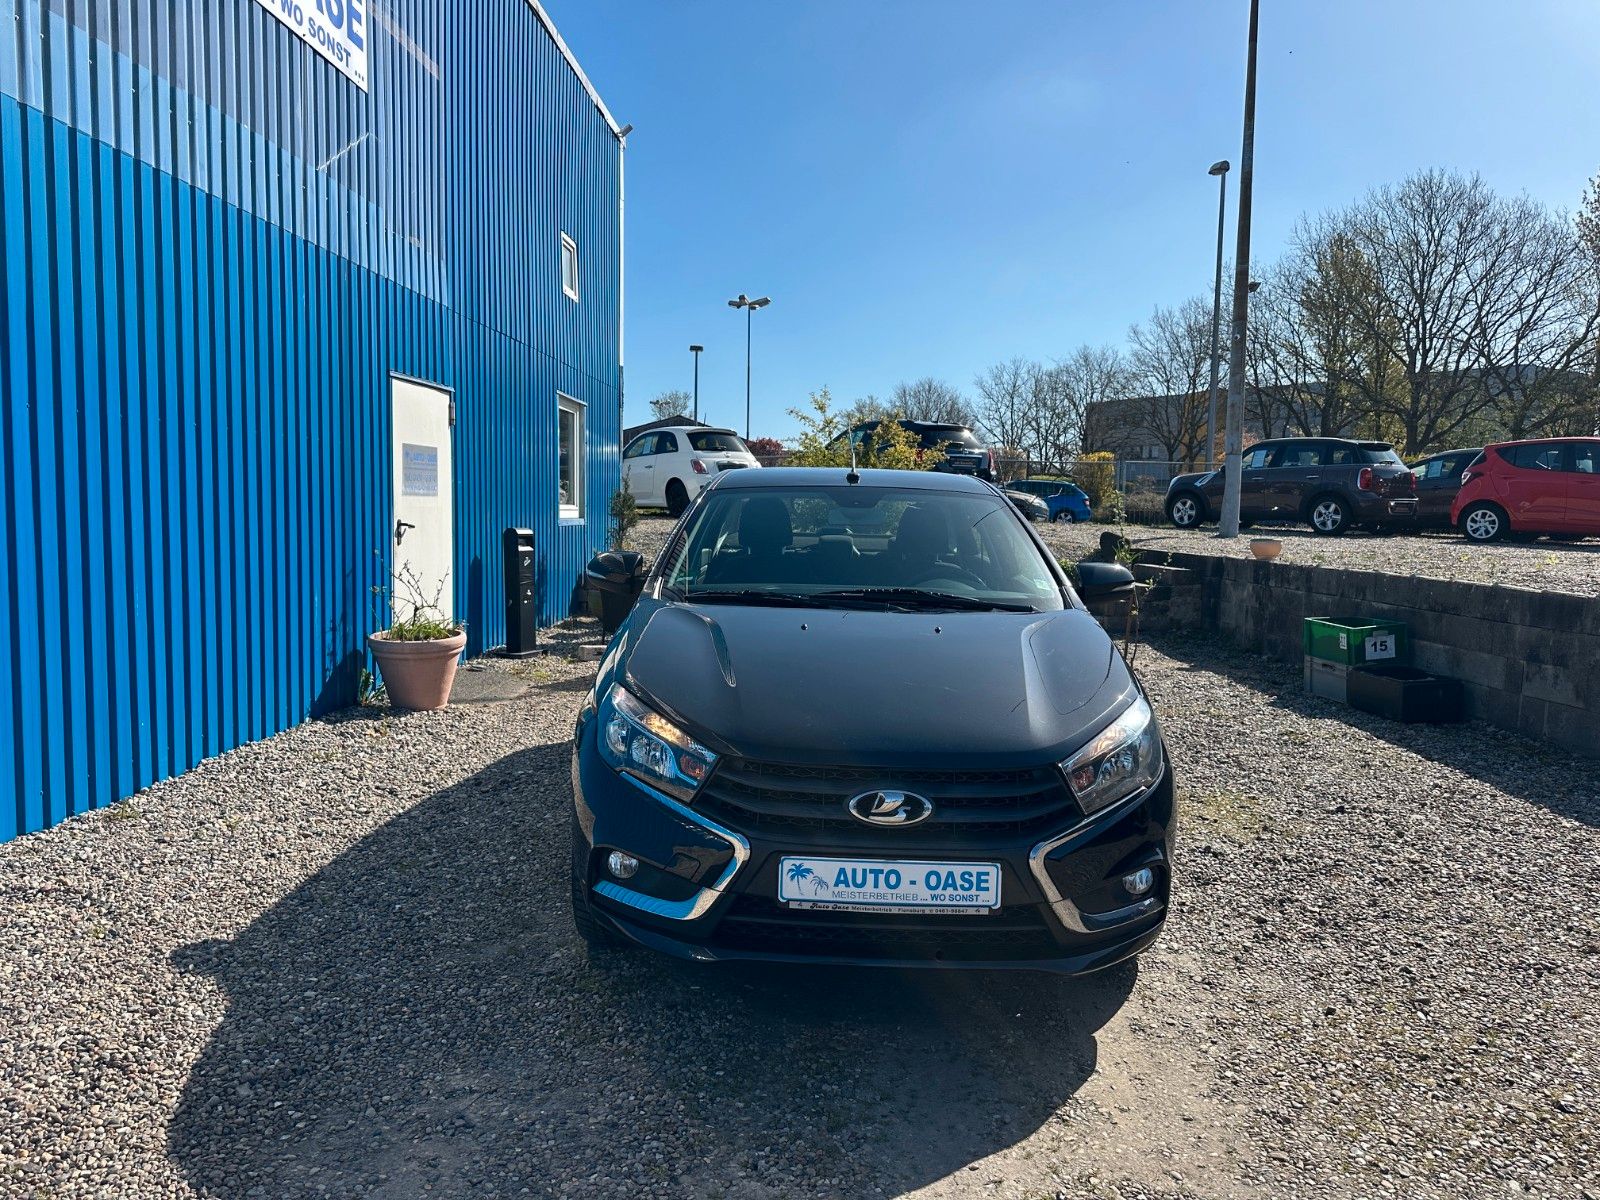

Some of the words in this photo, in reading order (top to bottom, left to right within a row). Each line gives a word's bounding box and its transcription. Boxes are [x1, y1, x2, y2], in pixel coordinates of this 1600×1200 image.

[308, 17, 351, 68] SONST
[1370, 640, 1388, 653] 15
[833, 867, 902, 890] AUTO
[925, 870, 990, 892] OASE
[930, 893, 947, 902] WO
[948, 894, 980, 903] SONST
